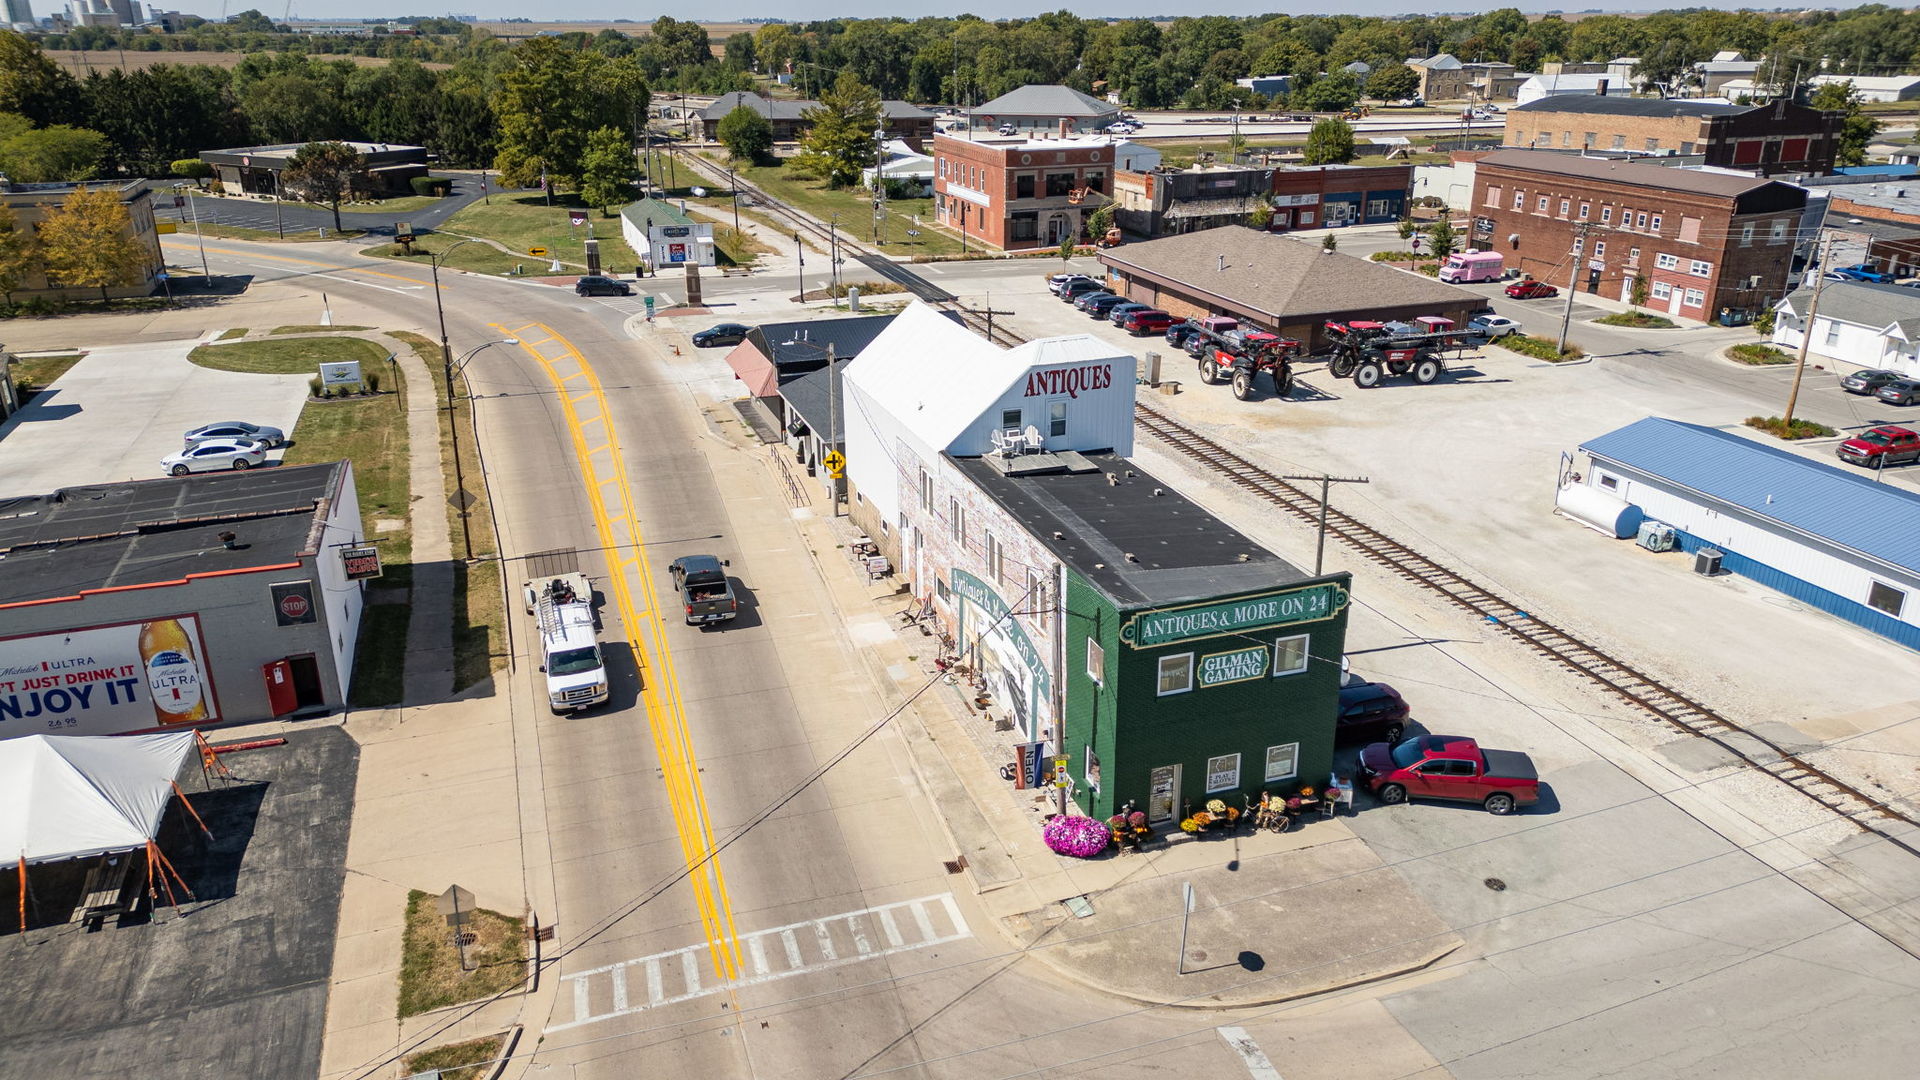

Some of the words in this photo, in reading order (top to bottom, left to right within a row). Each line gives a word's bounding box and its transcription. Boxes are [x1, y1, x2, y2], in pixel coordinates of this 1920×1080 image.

[1024, 364, 1111, 399] ANTIQUES
[345, 556, 377, 567] VIDEO
[347, 563, 378, 573] SLOTS
[283, 601, 306, 612] STOP
[1143, 611, 1219, 638] ANTIQUES
[1219, 612, 1230, 627] &
[1233, 601, 1279, 624] MORE
[1281, 597, 1304, 616] ON
[1309, 594, 1328, 611] 24
[51, 656, 95, 669] ULTRA
[1031, 654, 1044, 684] 24
[1204, 650, 1264, 671] GILMAN
[22, 675, 60, 691] JUST
[65, 667, 118, 684] DRINK
[120, 664, 134, 677] IT
[151, 674, 198, 689] ULTRA
[1204, 663, 1262, 684] GAMING
[105, 678, 139, 705] IT
[1025, 750, 1035, 785] OPEN
